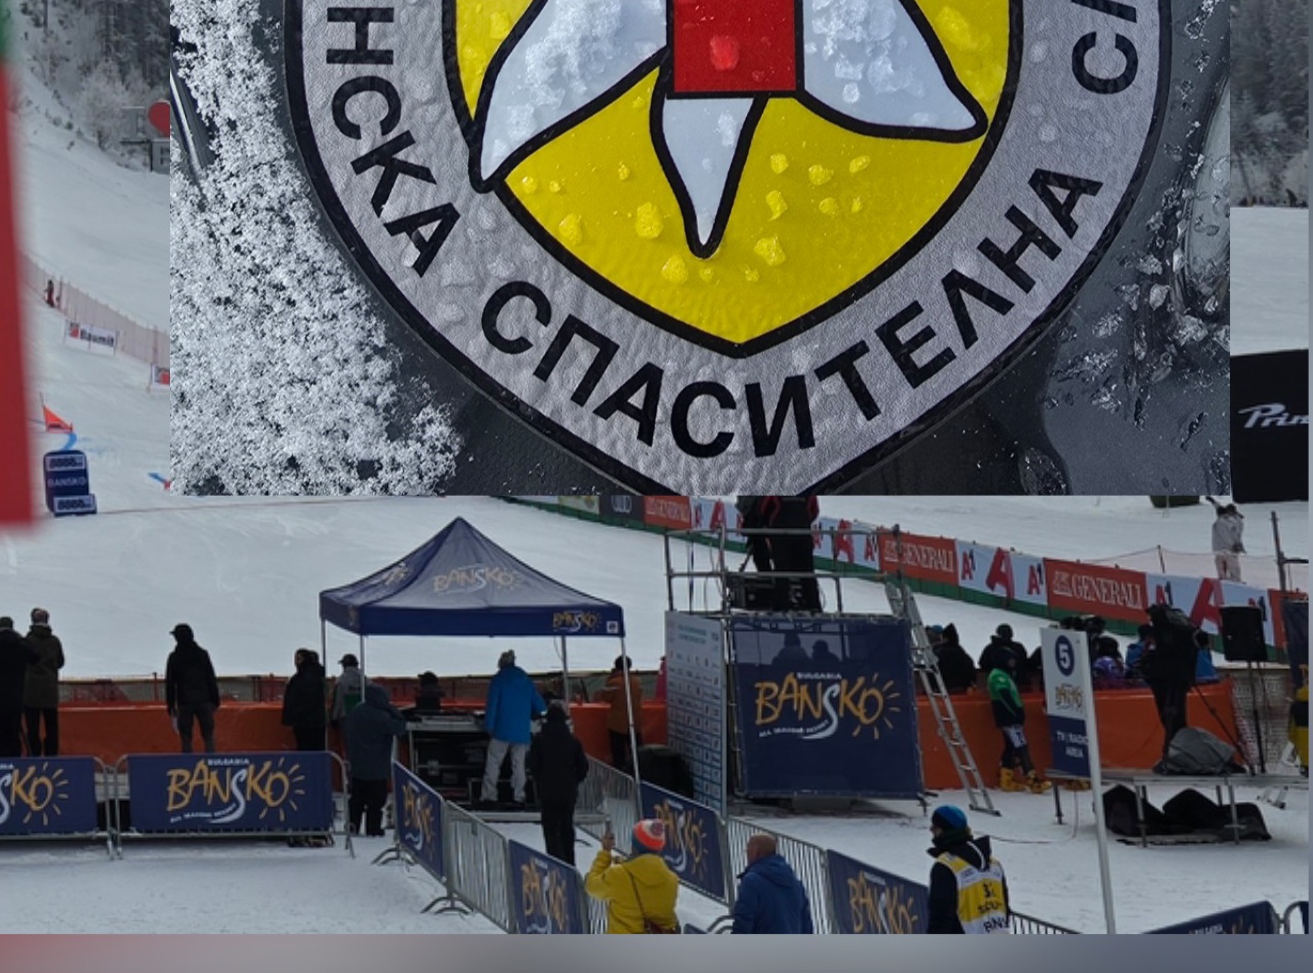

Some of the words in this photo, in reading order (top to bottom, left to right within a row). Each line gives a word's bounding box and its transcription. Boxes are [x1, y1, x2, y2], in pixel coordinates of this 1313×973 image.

[480, 162, 1103, 458] СПАСИТЕЛНА
[434, 566, 515, 593] BANSKO
[1071, 574, 1143, 610] GENERALI
[553, 611, 597, 632] BANSKO
[1058, 644, 1071, 669] 5
[755, 673, 884, 739] BANSKO
[167, 759, 290, 823] BANSKO
[848, 871, 914, 934] BANSKO
